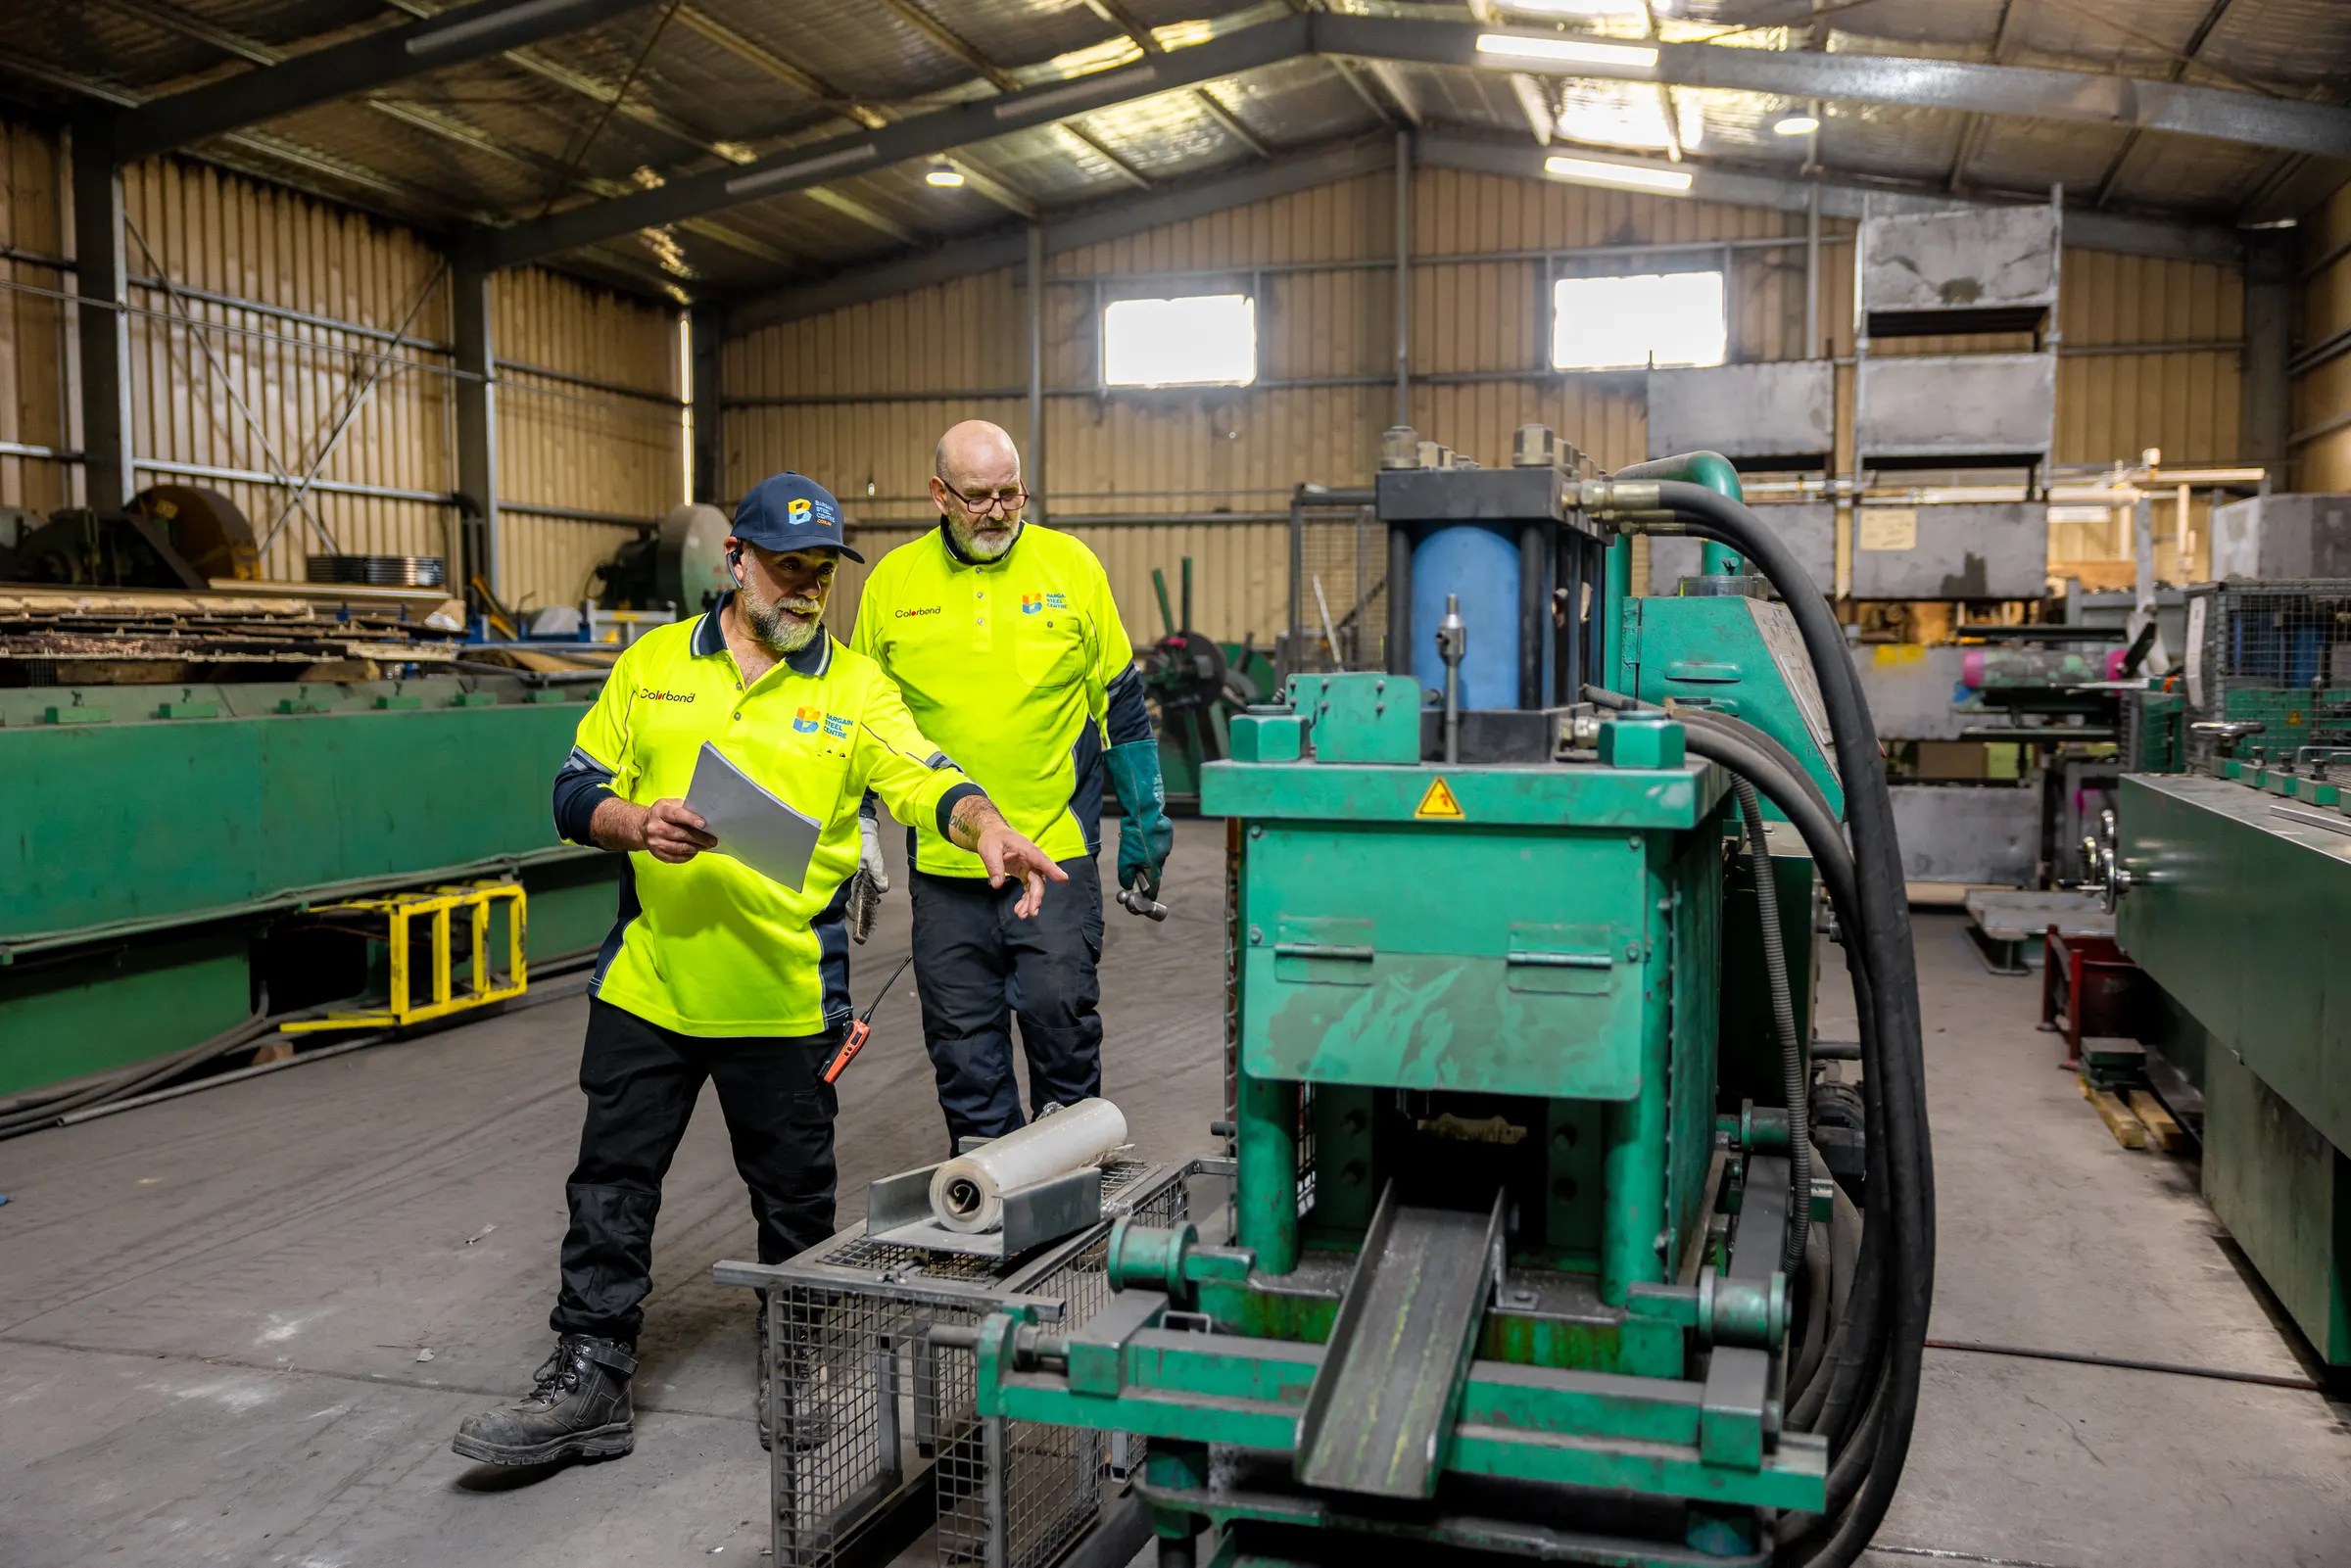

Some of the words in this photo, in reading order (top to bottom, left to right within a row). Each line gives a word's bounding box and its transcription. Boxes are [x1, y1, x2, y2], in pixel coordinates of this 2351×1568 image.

[788, 499, 812, 525] B
[894, 605, 941, 618] Colorbond
[640, 688, 696, 703] Colorbond
[825, 719, 842, 731] STEEL
[826, 712, 853, 726] BARGAIN
[823, 726, 847, 739] CENTRE
